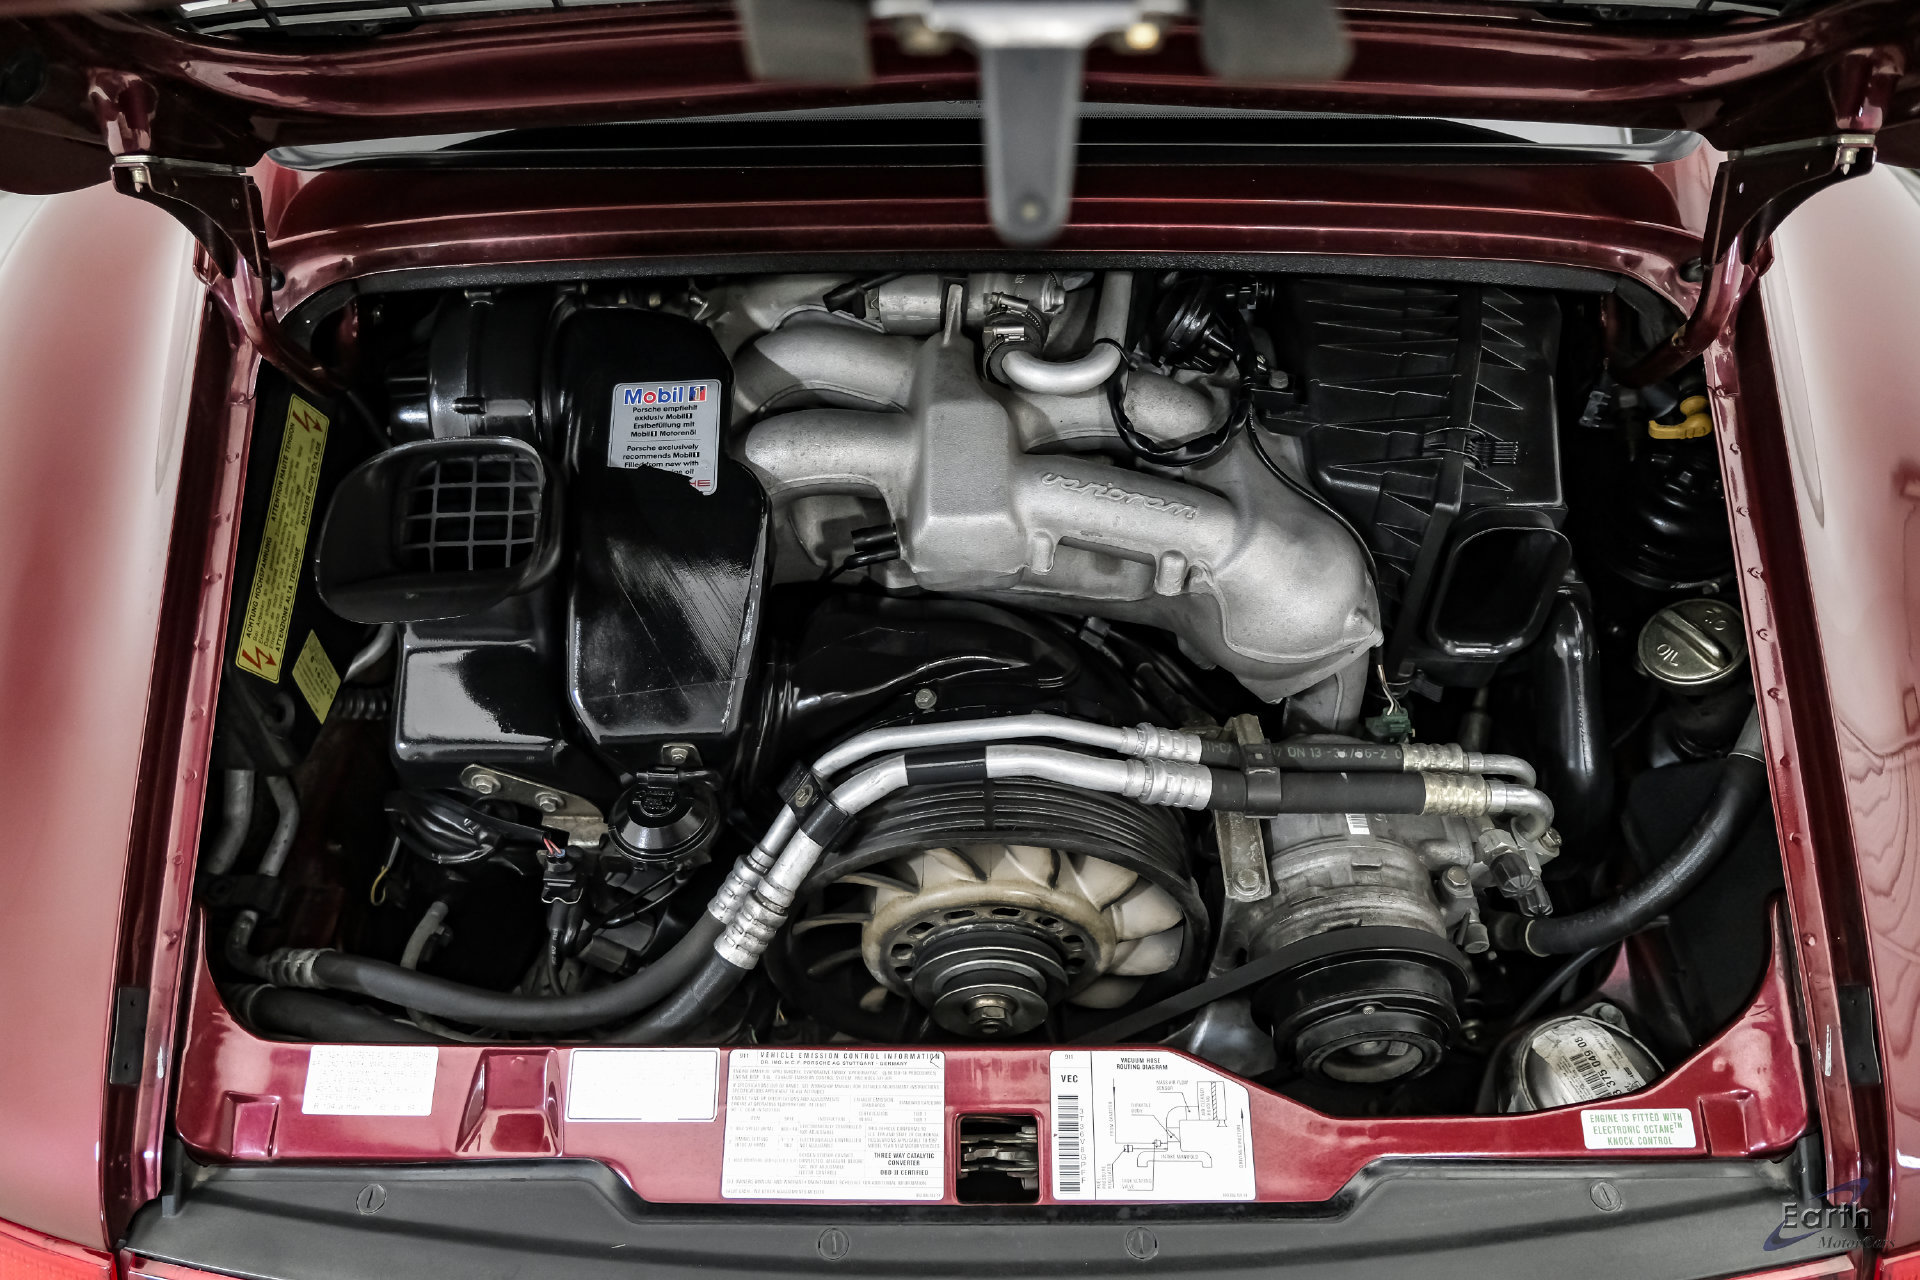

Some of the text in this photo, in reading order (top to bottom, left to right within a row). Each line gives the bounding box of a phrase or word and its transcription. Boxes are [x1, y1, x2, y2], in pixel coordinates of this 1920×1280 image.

[625, 387, 683, 404] Mobil
[272, 481, 284, 522] ATTENTION
[286, 422, 295, 452] TENSION
[300, 495, 311, 525] DANGER
[247, 536, 272, 638] ACHTUNG HOCHSPANNUNG
[276, 606, 289, 652] ATTENZIONE
[290, 546, 301, 582] TENSIONE
[1657, 643, 1678, 666] OIL
[1574, 1037, 1586, 1047] 08
[1584, 1050, 1601, 1067] 049
[1061, 1075, 1078, 1083] VEC
[1598, 1069, 1616, 1087] 375
[1590, 1113, 1682, 1123] ENGINE IS FITTED WITH
[1593, 1125, 1640, 1134] ELECTRONIC
[1608, 1136, 1672, 1145] KNOCK CONTROL
